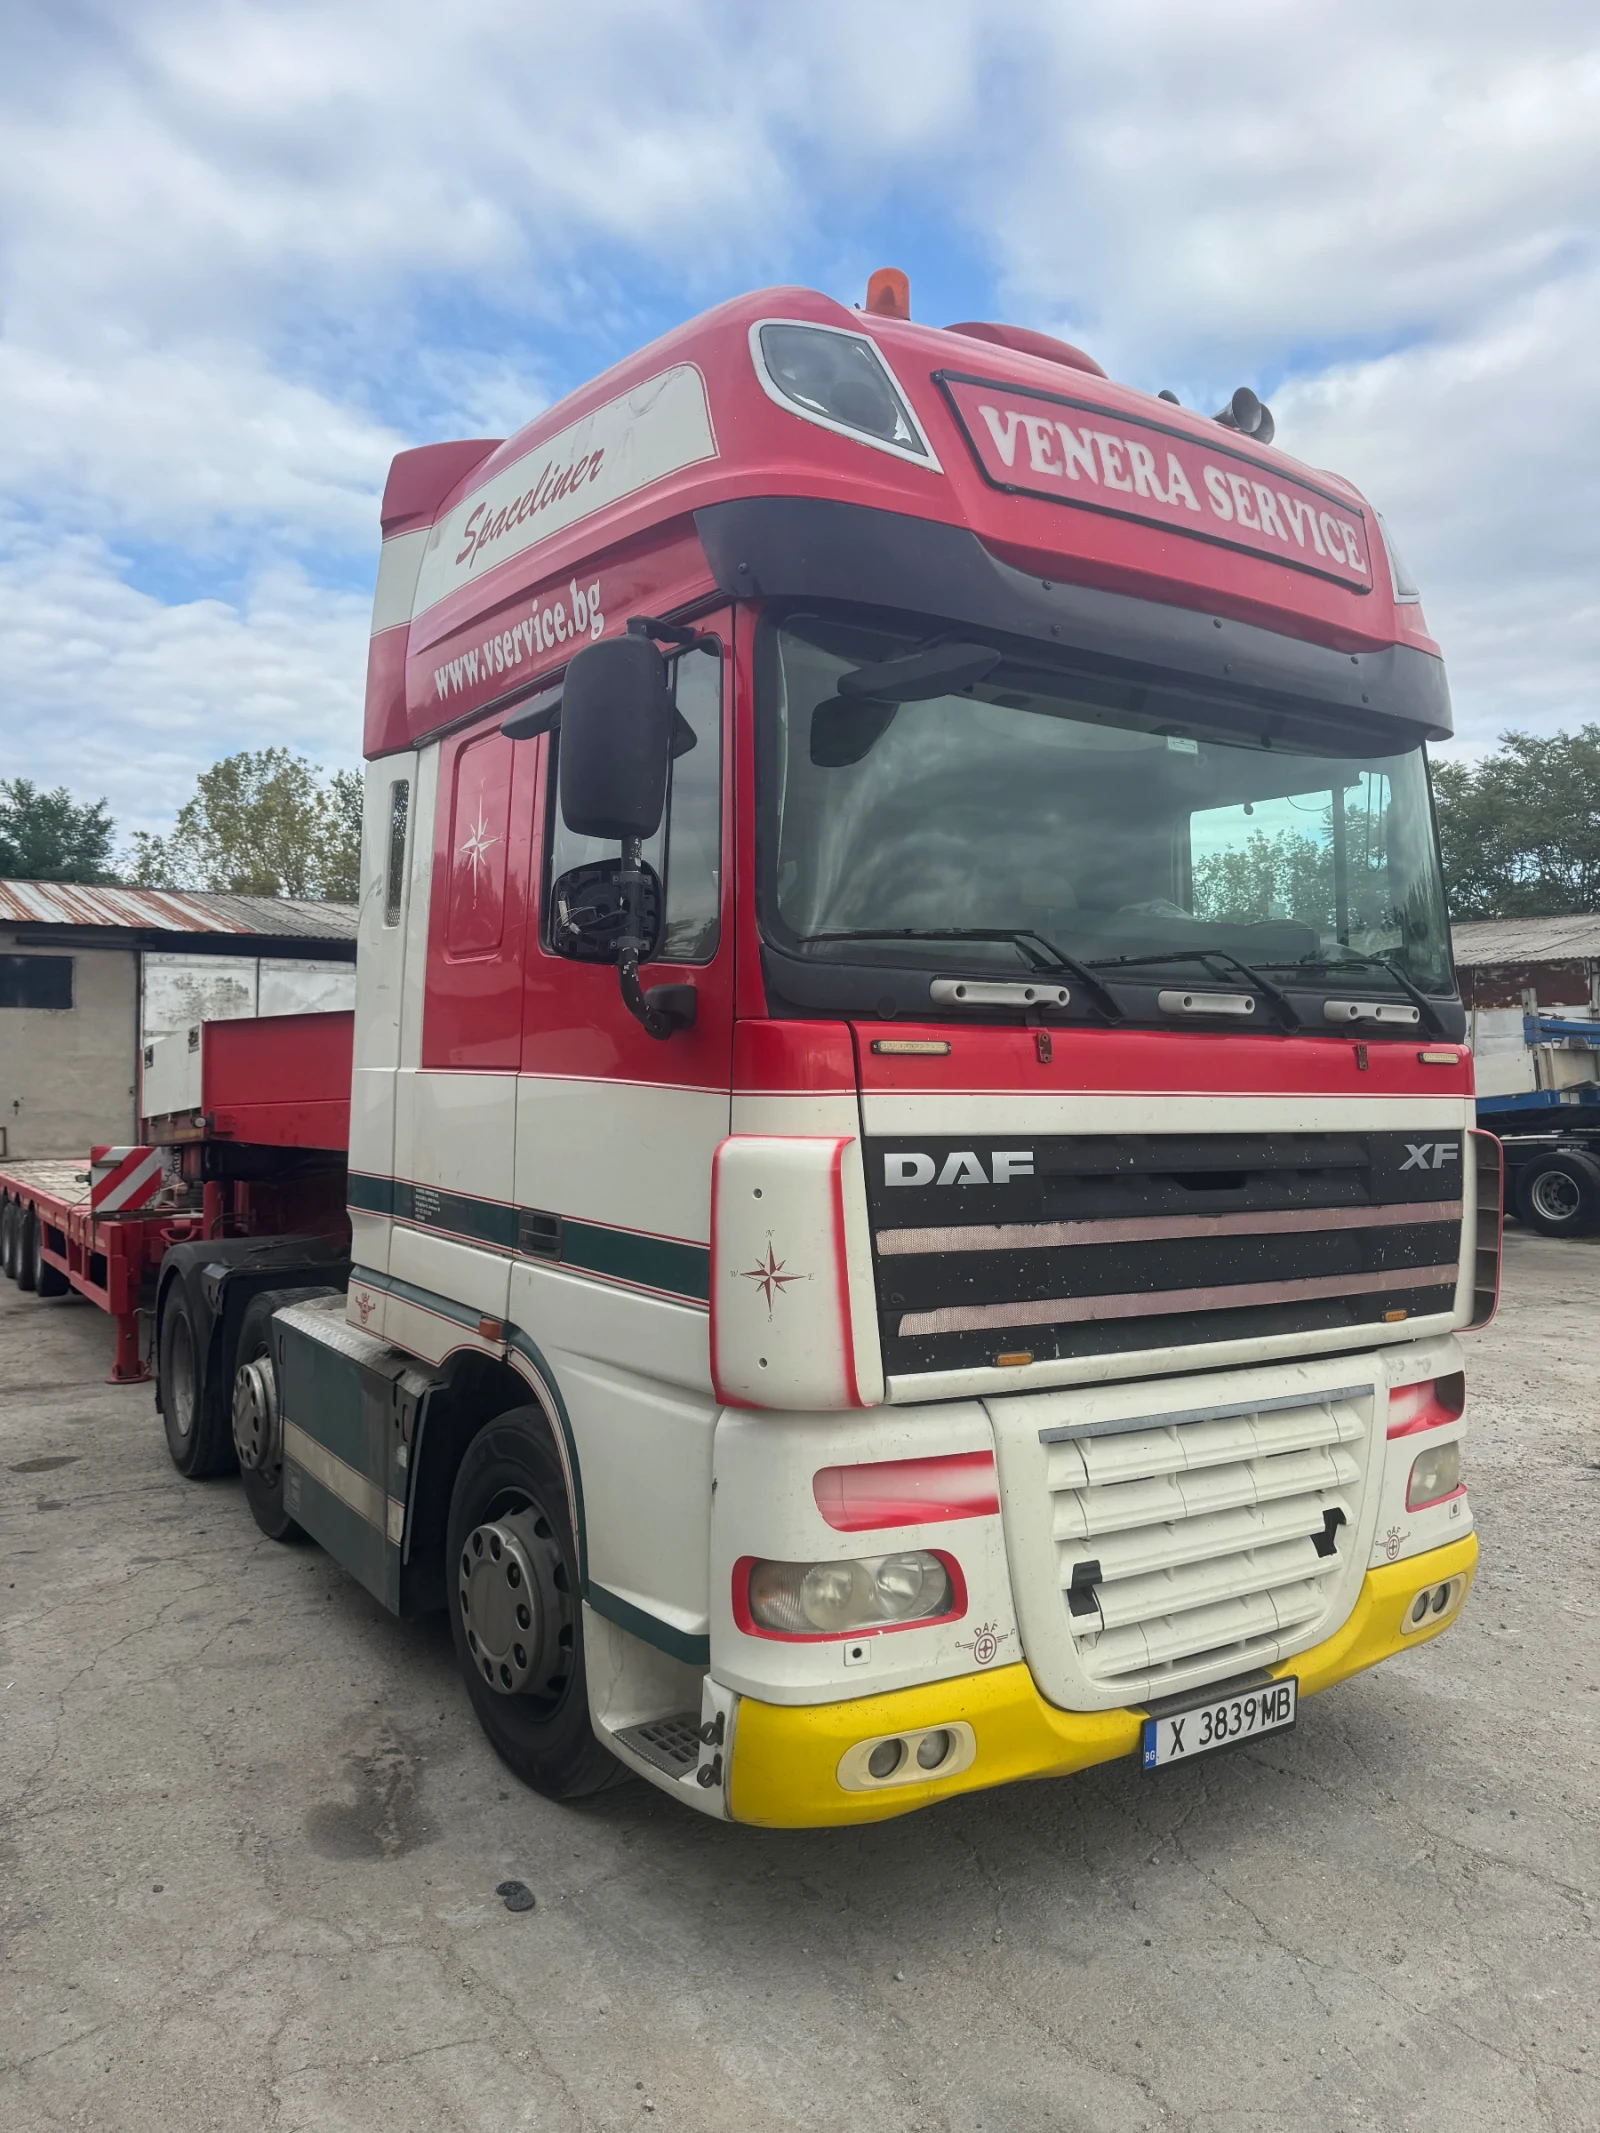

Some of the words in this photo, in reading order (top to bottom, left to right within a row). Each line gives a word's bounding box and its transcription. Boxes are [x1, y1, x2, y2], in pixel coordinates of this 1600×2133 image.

[455, 446, 606, 570] Spaceliner
[978, 405, 1201, 513] VENERA
[1202, 464, 1368, 575] SERVICE
[433, 577, 606, 701] www.vservice.bg
[884, 1150, 1035, 1188] DAF
[1399, 1142, 1459, 1171] XF
[973, 1621, 998, 1638] DAF
[1144, 1749, 1156, 1763] BG
[1169, 1717, 1186, 1757] X
